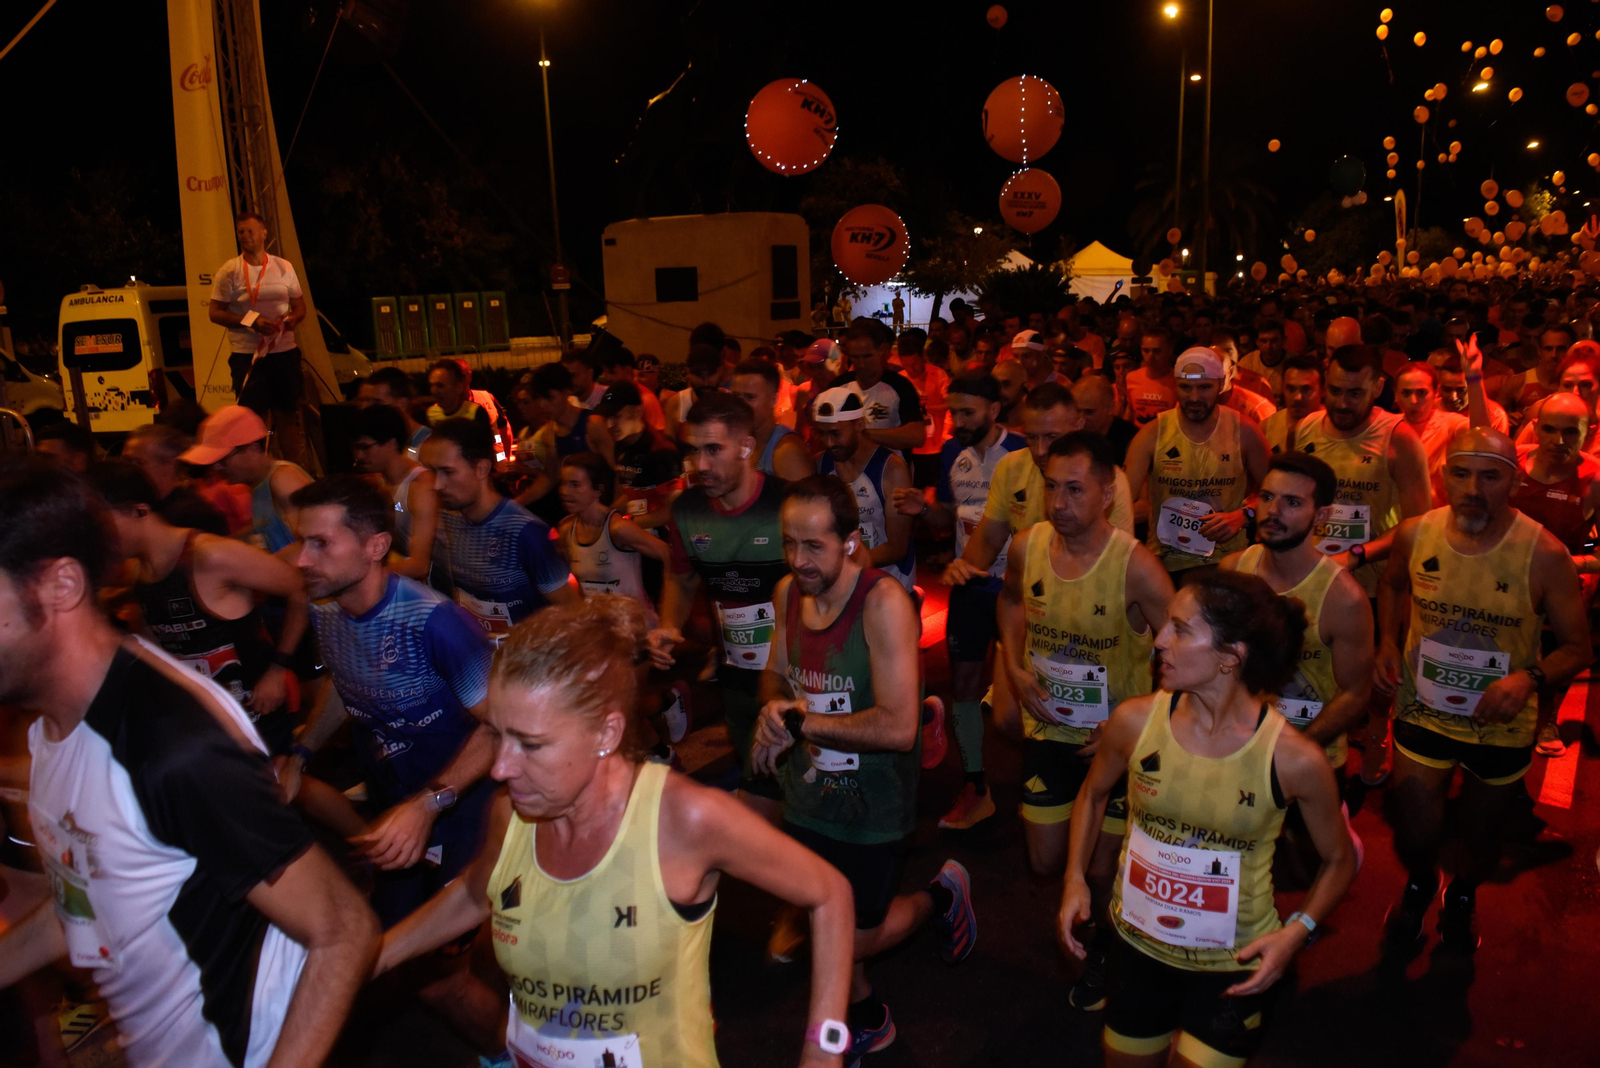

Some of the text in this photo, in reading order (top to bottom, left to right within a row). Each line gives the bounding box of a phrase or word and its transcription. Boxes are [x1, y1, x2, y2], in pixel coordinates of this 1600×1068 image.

[1013, 191, 1041, 200] XXXV
[68, 295, 125, 307] AMBULANCIA
[1158, 476, 1197, 488] AMIGOS
[1315, 523, 1351, 538] 5021
[1420, 611, 1498, 639] MIRAFLORES
[1452, 604, 1523, 629] PIRÁMIDE
[730, 630, 755, 643] 687
[1061, 630, 1120, 652] PIRÁMIDE
[1031, 638, 1101, 666] MIRAFLORES
[1435, 668, 1484, 689] 2527
[1045, 681, 1086, 702] 5023
[1181, 821, 1257, 852] PIRÁMIDE
[1144, 872, 1206, 909] 5024
[1179, 906, 1202, 917] RAMOS
[553, 977, 662, 1007] PIRÁMIDE
[515, 1000, 625, 1033] MIRAFLORES
